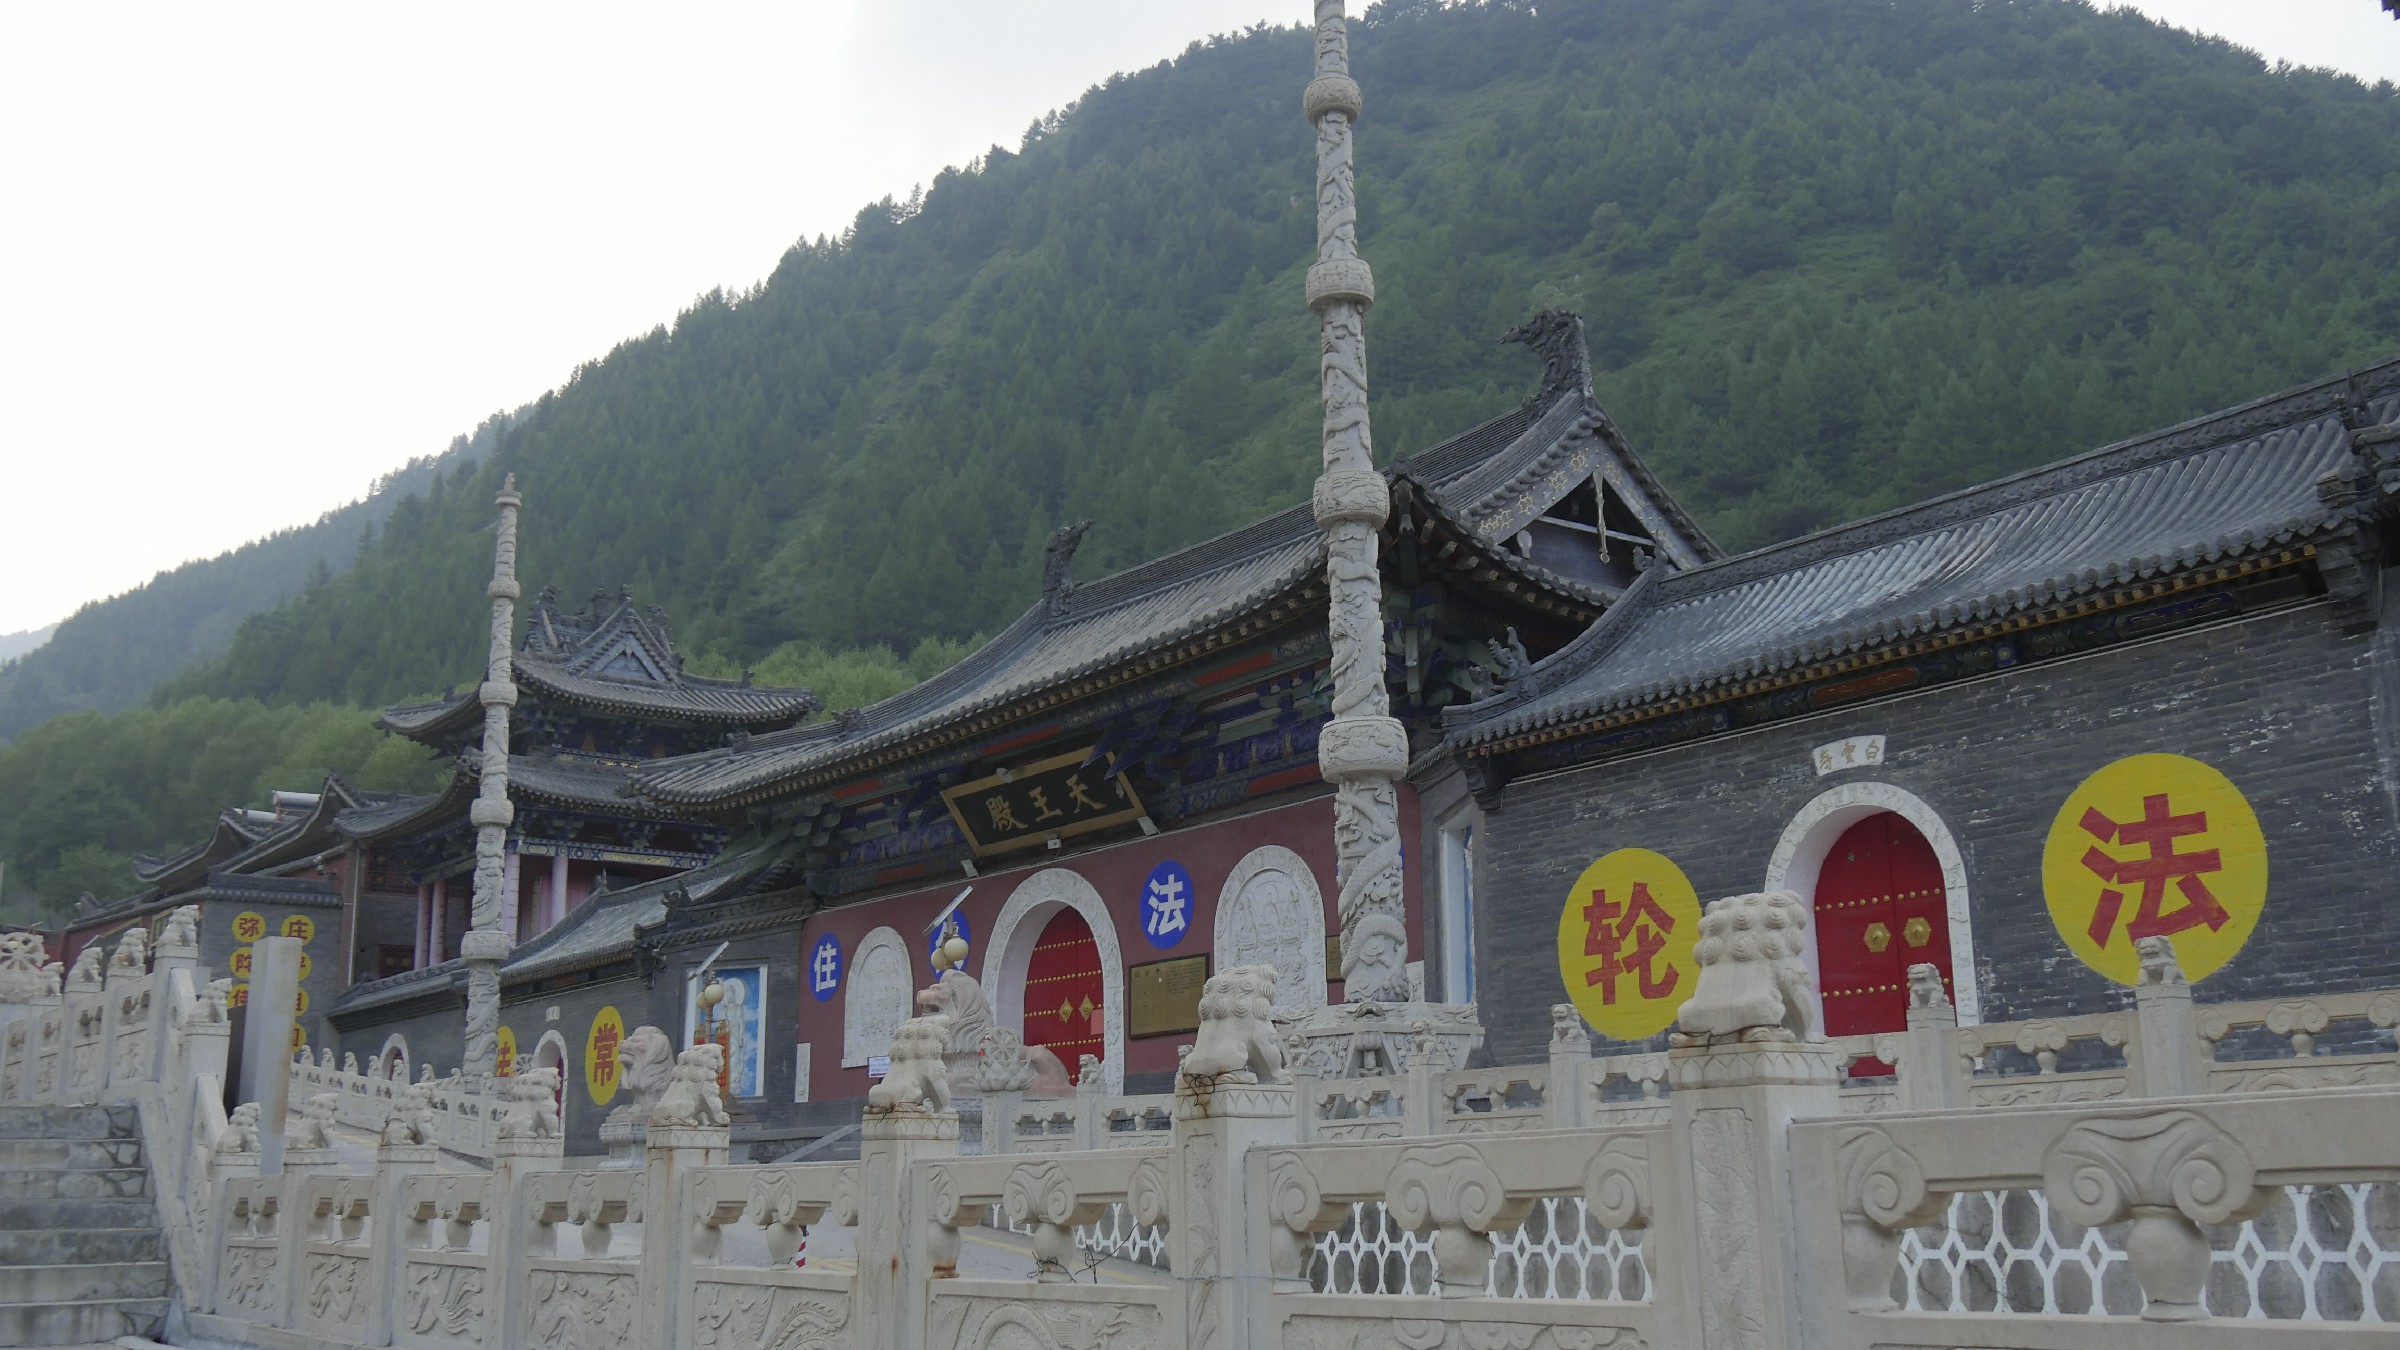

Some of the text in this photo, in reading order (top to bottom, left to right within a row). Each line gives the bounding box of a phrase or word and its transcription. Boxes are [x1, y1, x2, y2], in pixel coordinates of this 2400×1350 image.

[813, 873, 1186, 993] 法 住
[1583, 792, 2231, 1006] 法 轮
[593, 1023, 618, 1087] 常
